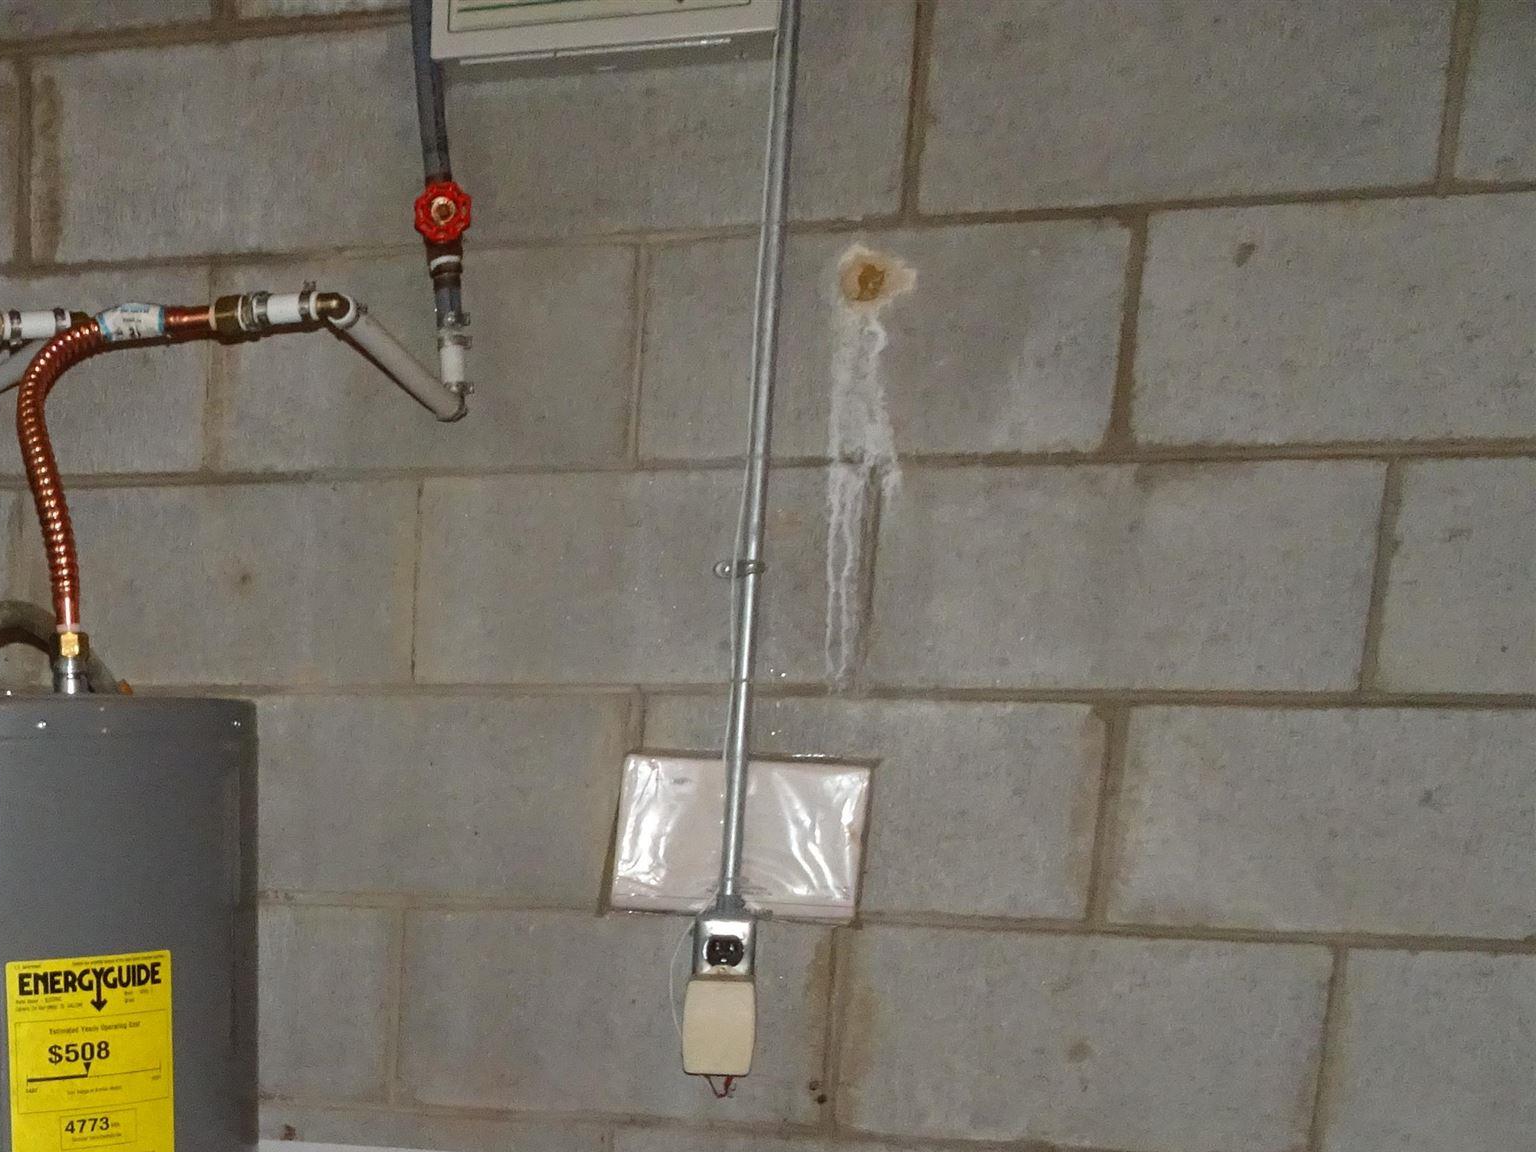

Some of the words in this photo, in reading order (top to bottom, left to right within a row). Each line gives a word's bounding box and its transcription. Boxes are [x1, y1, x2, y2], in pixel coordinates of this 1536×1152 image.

[18, 962, 162, 997] ENERGYGUIDE
[48, 1040, 111, 1066] $508
[65, 1116, 110, 1134] 4773
